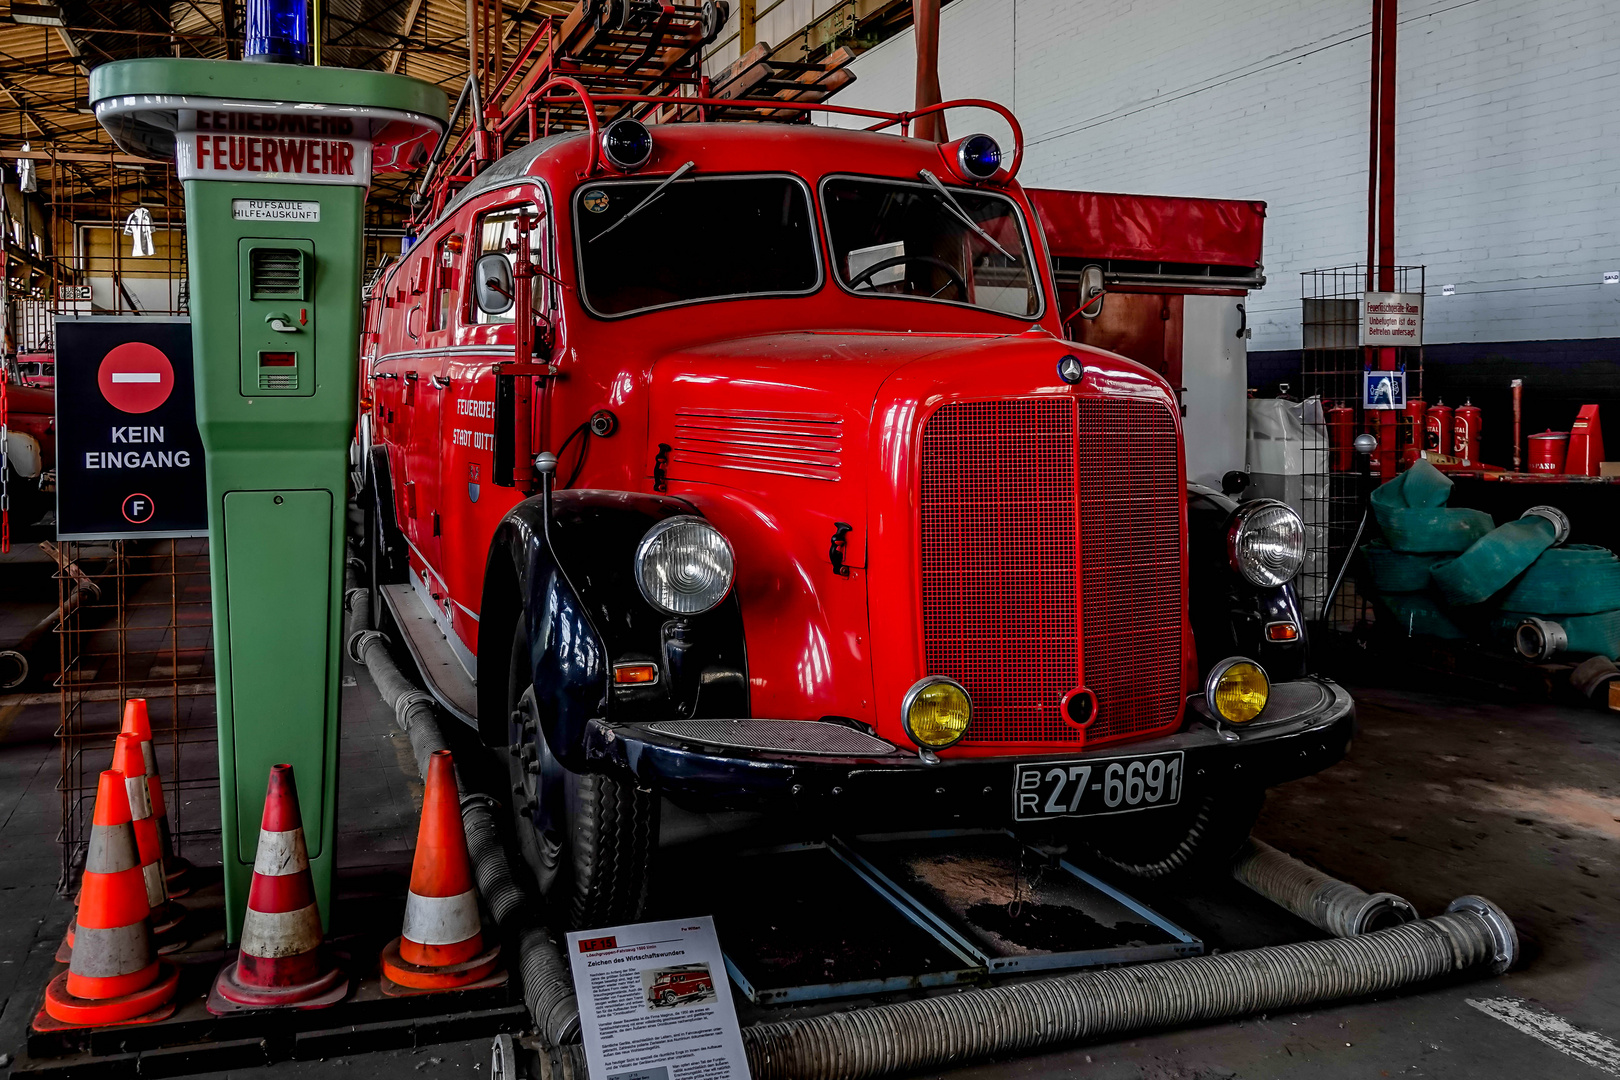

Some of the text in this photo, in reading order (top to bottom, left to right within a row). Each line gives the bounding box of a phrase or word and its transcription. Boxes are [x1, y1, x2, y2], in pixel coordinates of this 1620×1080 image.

[196, 135, 354, 176] FEUERWEHR
[81, 287, 90, 298] 2
[1369, 317, 1397, 327] Unbefugten
[1407, 318, 1416, 326] das
[1369, 327, 1390, 335] Betreten
[112, 426, 164, 443] KEIN
[86, 451, 190, 469] EINGANG
[134, 501, 144, 516] F
[1021, 771, 1041, 790] B
[1045, 758, 1180, 812] 27-6691
[1021, 794, 1038, 813] R
[584, 939, 612, 950] LF 15
[626, 950, 685, 962] Wirtschaftswunders
